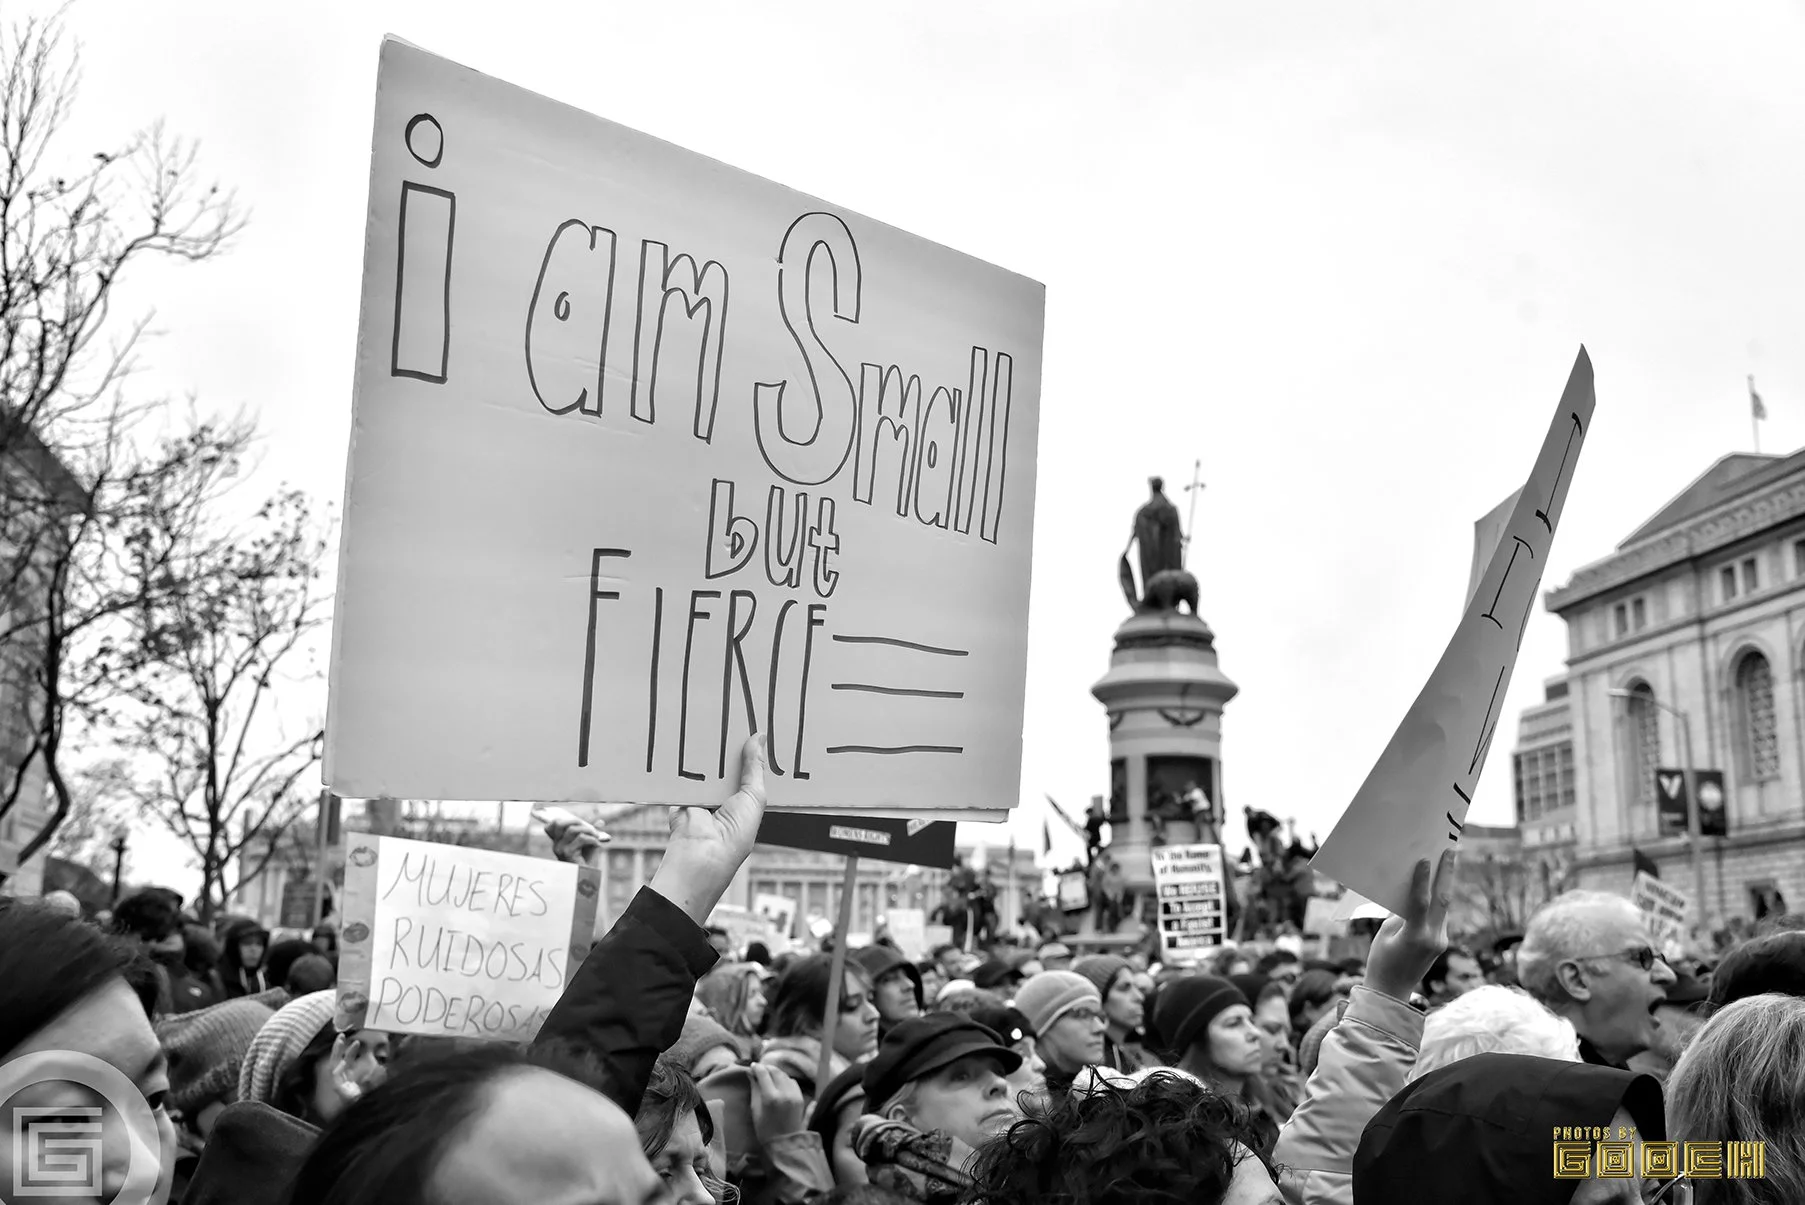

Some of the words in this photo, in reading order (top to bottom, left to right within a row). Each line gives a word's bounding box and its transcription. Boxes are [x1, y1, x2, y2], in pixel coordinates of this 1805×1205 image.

[391, 113, 456, 384] i
[525, 218, 730, 444] am
[754, 211, 1013, 545] Small
[705, 478, 840, 599] but
[578, 547, 830, 782] FIERCE
[382, 852, 548, 916] MUJERES
[390, 917, 563, 989] RUIDOSAS
